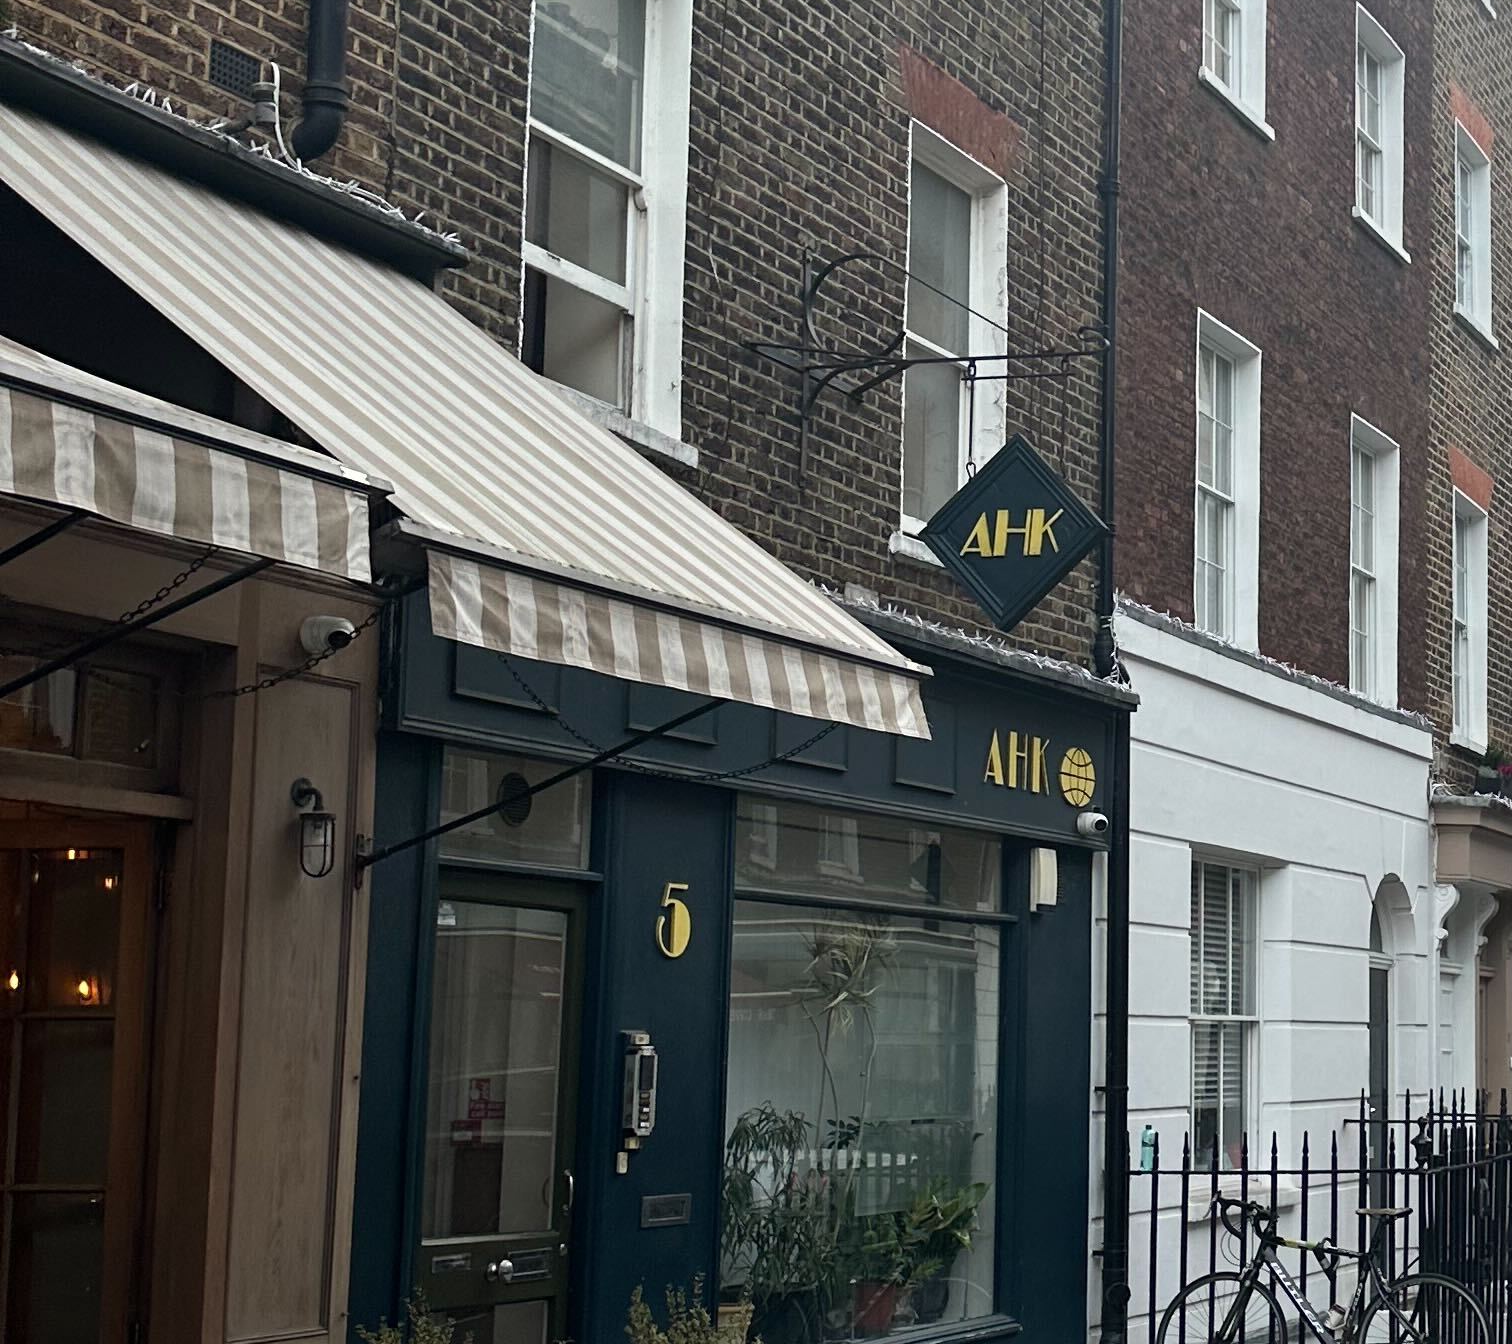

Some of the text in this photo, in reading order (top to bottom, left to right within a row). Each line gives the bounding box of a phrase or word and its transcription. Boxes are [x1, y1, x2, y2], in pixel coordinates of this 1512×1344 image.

[960, 508, 1064, 558] AHK
[984, 728, 1050, 796] AHK
[656, 882, 691, 957] 5
